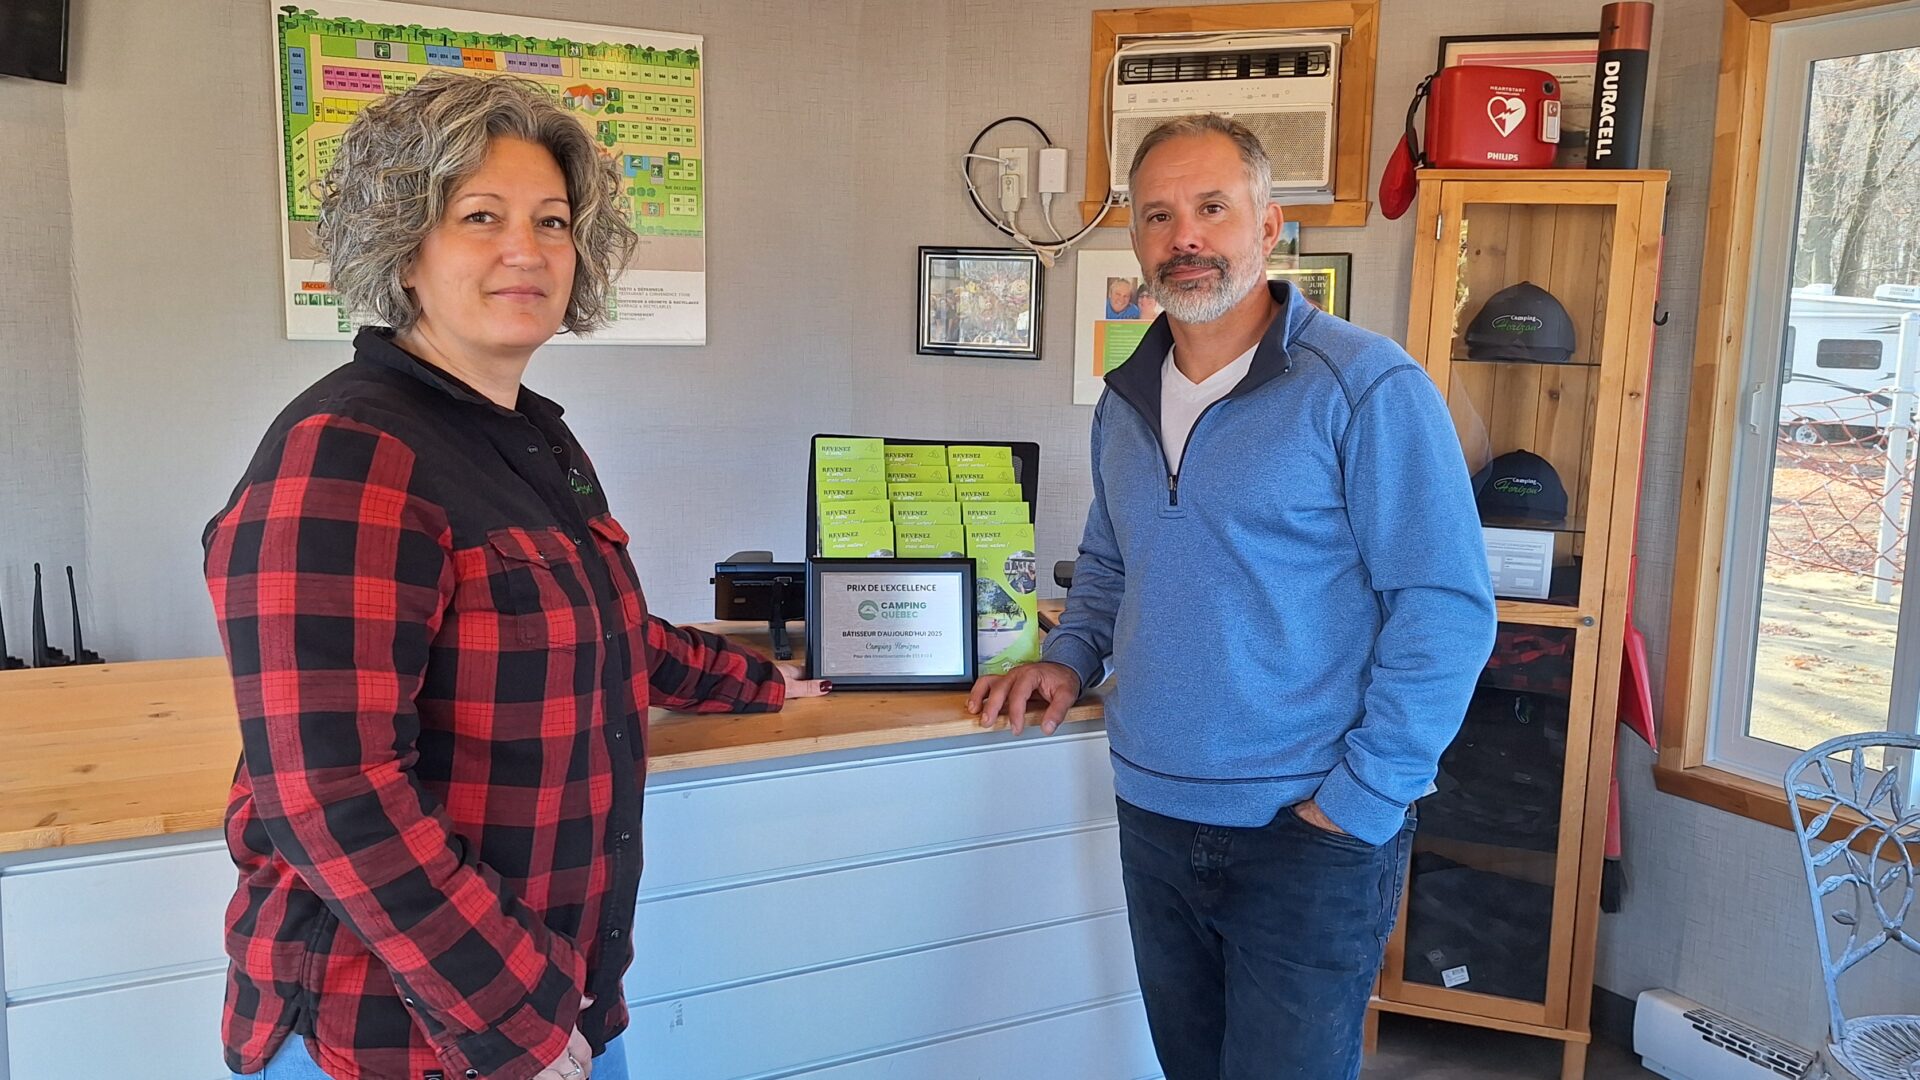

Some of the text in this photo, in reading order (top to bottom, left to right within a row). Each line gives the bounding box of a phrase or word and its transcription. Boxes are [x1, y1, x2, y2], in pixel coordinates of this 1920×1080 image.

[1489, 85, 1526, 93] HEARTSTART
[1595, 60, 1621, 161] DURACELL
[1487, 151, 1519, 162] PHILIPS
[1510, 314, 1537, 322] Camping
[1512, 477, 1537, 485] Camping
[1496, 480, 1538, 496] Horizon
[846, 584, 937, 592] PRIX DE L'EXCELLENCE
[881, 602, 927, 610] CAMPING
[881, 609, 919, 619] QUÉBEC
[865, 641, 920, 652] Camping Horizon
